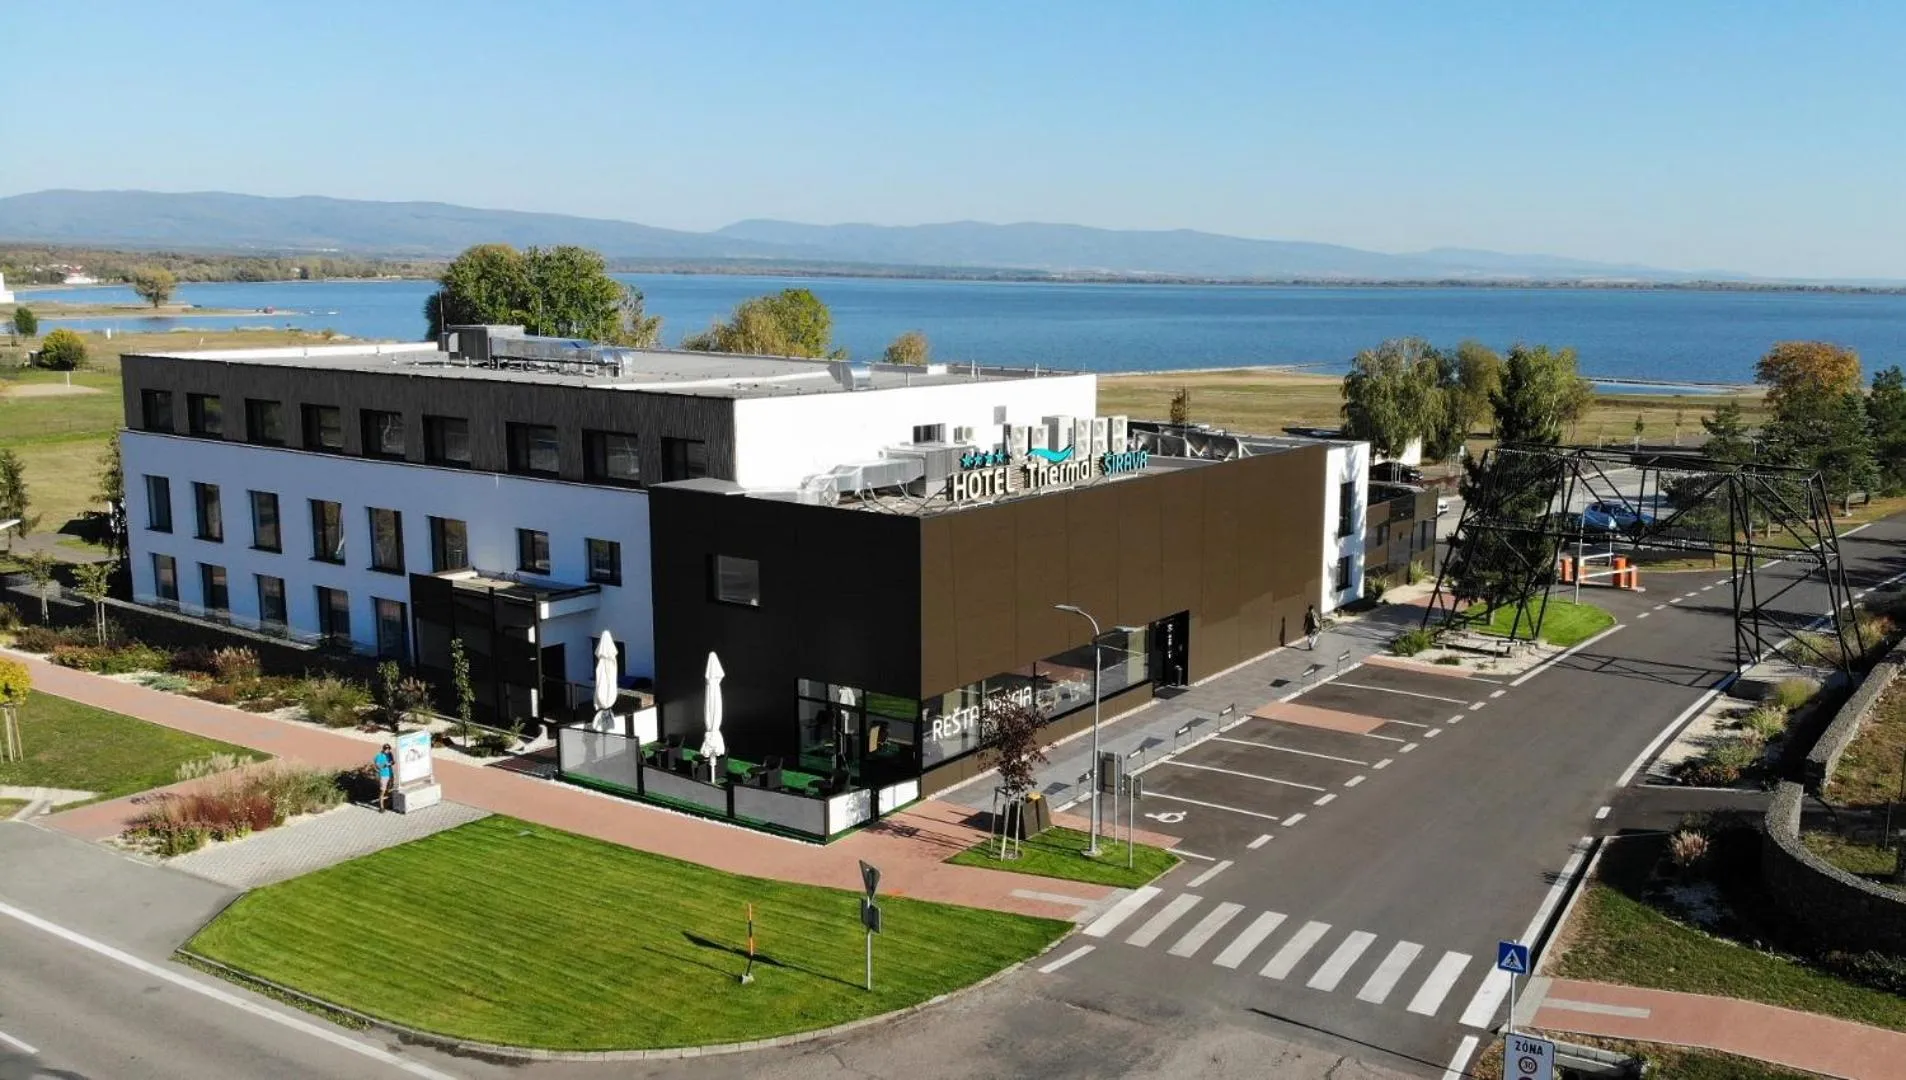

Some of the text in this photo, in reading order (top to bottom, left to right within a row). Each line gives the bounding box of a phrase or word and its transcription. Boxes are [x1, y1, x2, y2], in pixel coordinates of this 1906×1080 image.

[952, 464, 1016, 501] HOTEL
[1026, 454, 1094, 489] Thermal
[1515, 1040, 1543, 1056] ZÓNA
[1523, 1061, 1533, 1070] 30
